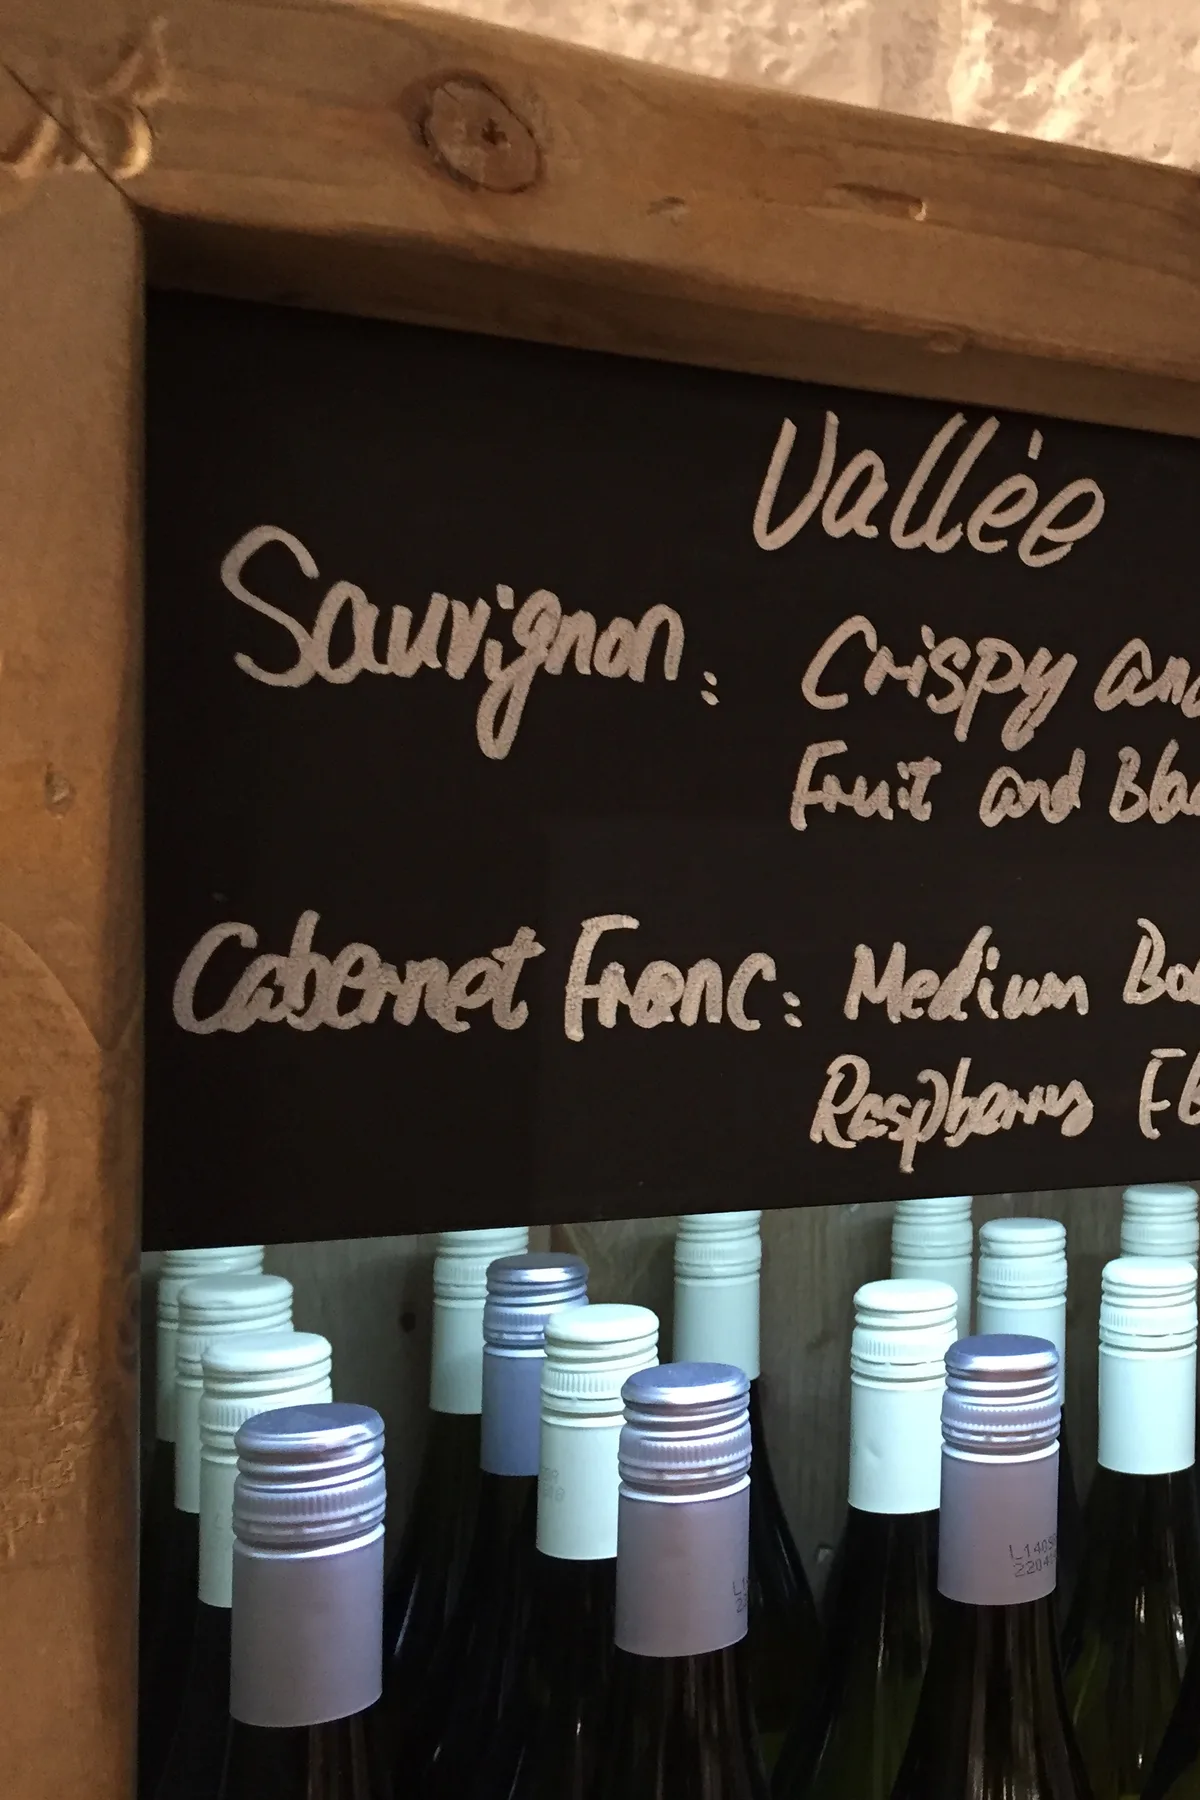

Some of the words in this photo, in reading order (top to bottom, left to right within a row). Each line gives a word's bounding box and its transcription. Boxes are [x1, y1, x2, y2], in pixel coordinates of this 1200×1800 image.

[802, 615, 1077, 751] Crispy
[790, 740, 941, 831] Fruit
[979, 748, 1085, 827] and
[173, 910, 546, 1034] Cabernet
[844, 926, 1089, 1024] Medium
